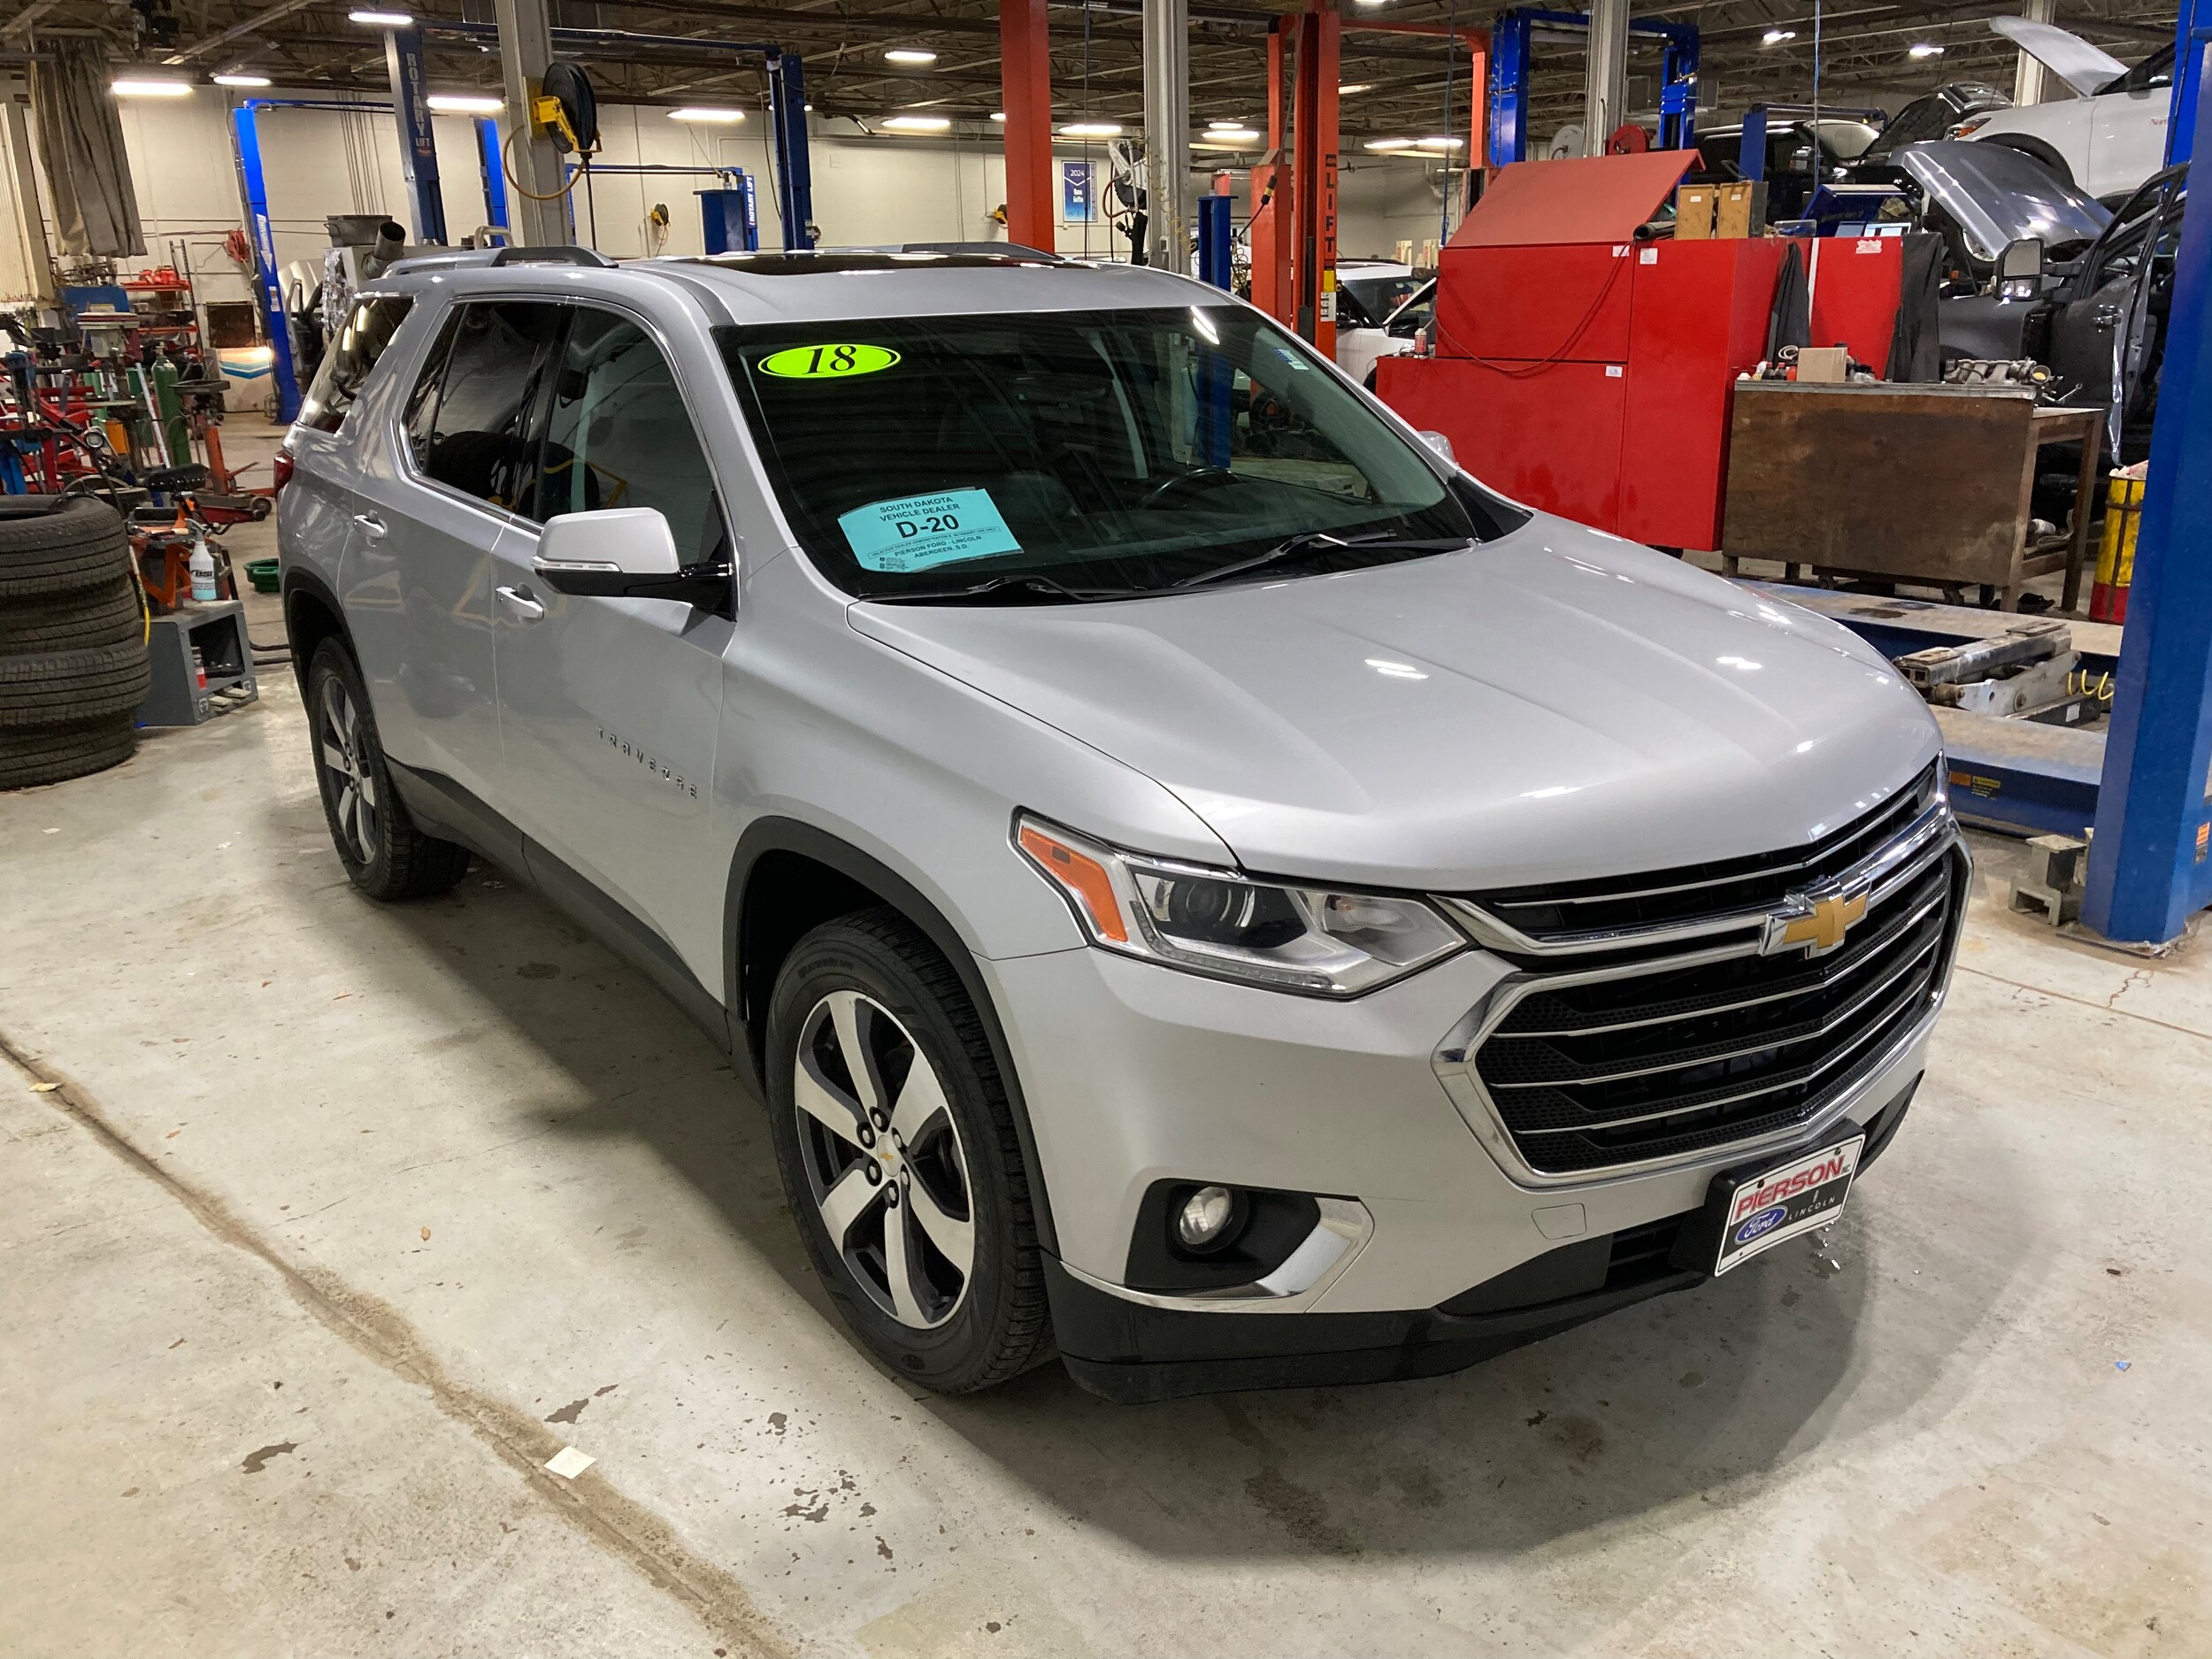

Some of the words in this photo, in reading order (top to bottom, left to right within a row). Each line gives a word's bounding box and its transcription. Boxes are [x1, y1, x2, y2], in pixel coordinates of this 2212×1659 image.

[407, 52, 425, 135] ROTARY
[802, 345, 856, 374] 18
[879, 502, 912, 513] SOUTH
[914, 496, 953, 508] DAKOTA
[879, 509, 919, 522] VEHICLE
[922, 503, 961, 514] DEALER
[895, 514, 959, 539] D-20
[895, 545, 926, 557] PIERSON
[927, 541, 947, 549] FORD
[951, 535, 982, 544] LINCOLN
[914, 545, 955, 558] ABERDEEN,
[597, 726, 697, 799] TRAVERSE
[1735, 1154, 1845, 1220] PIERSON
[1744, 1212, 1777, 1239] Ford
[1787, 1195, 1836, 1220] LINCOLN
